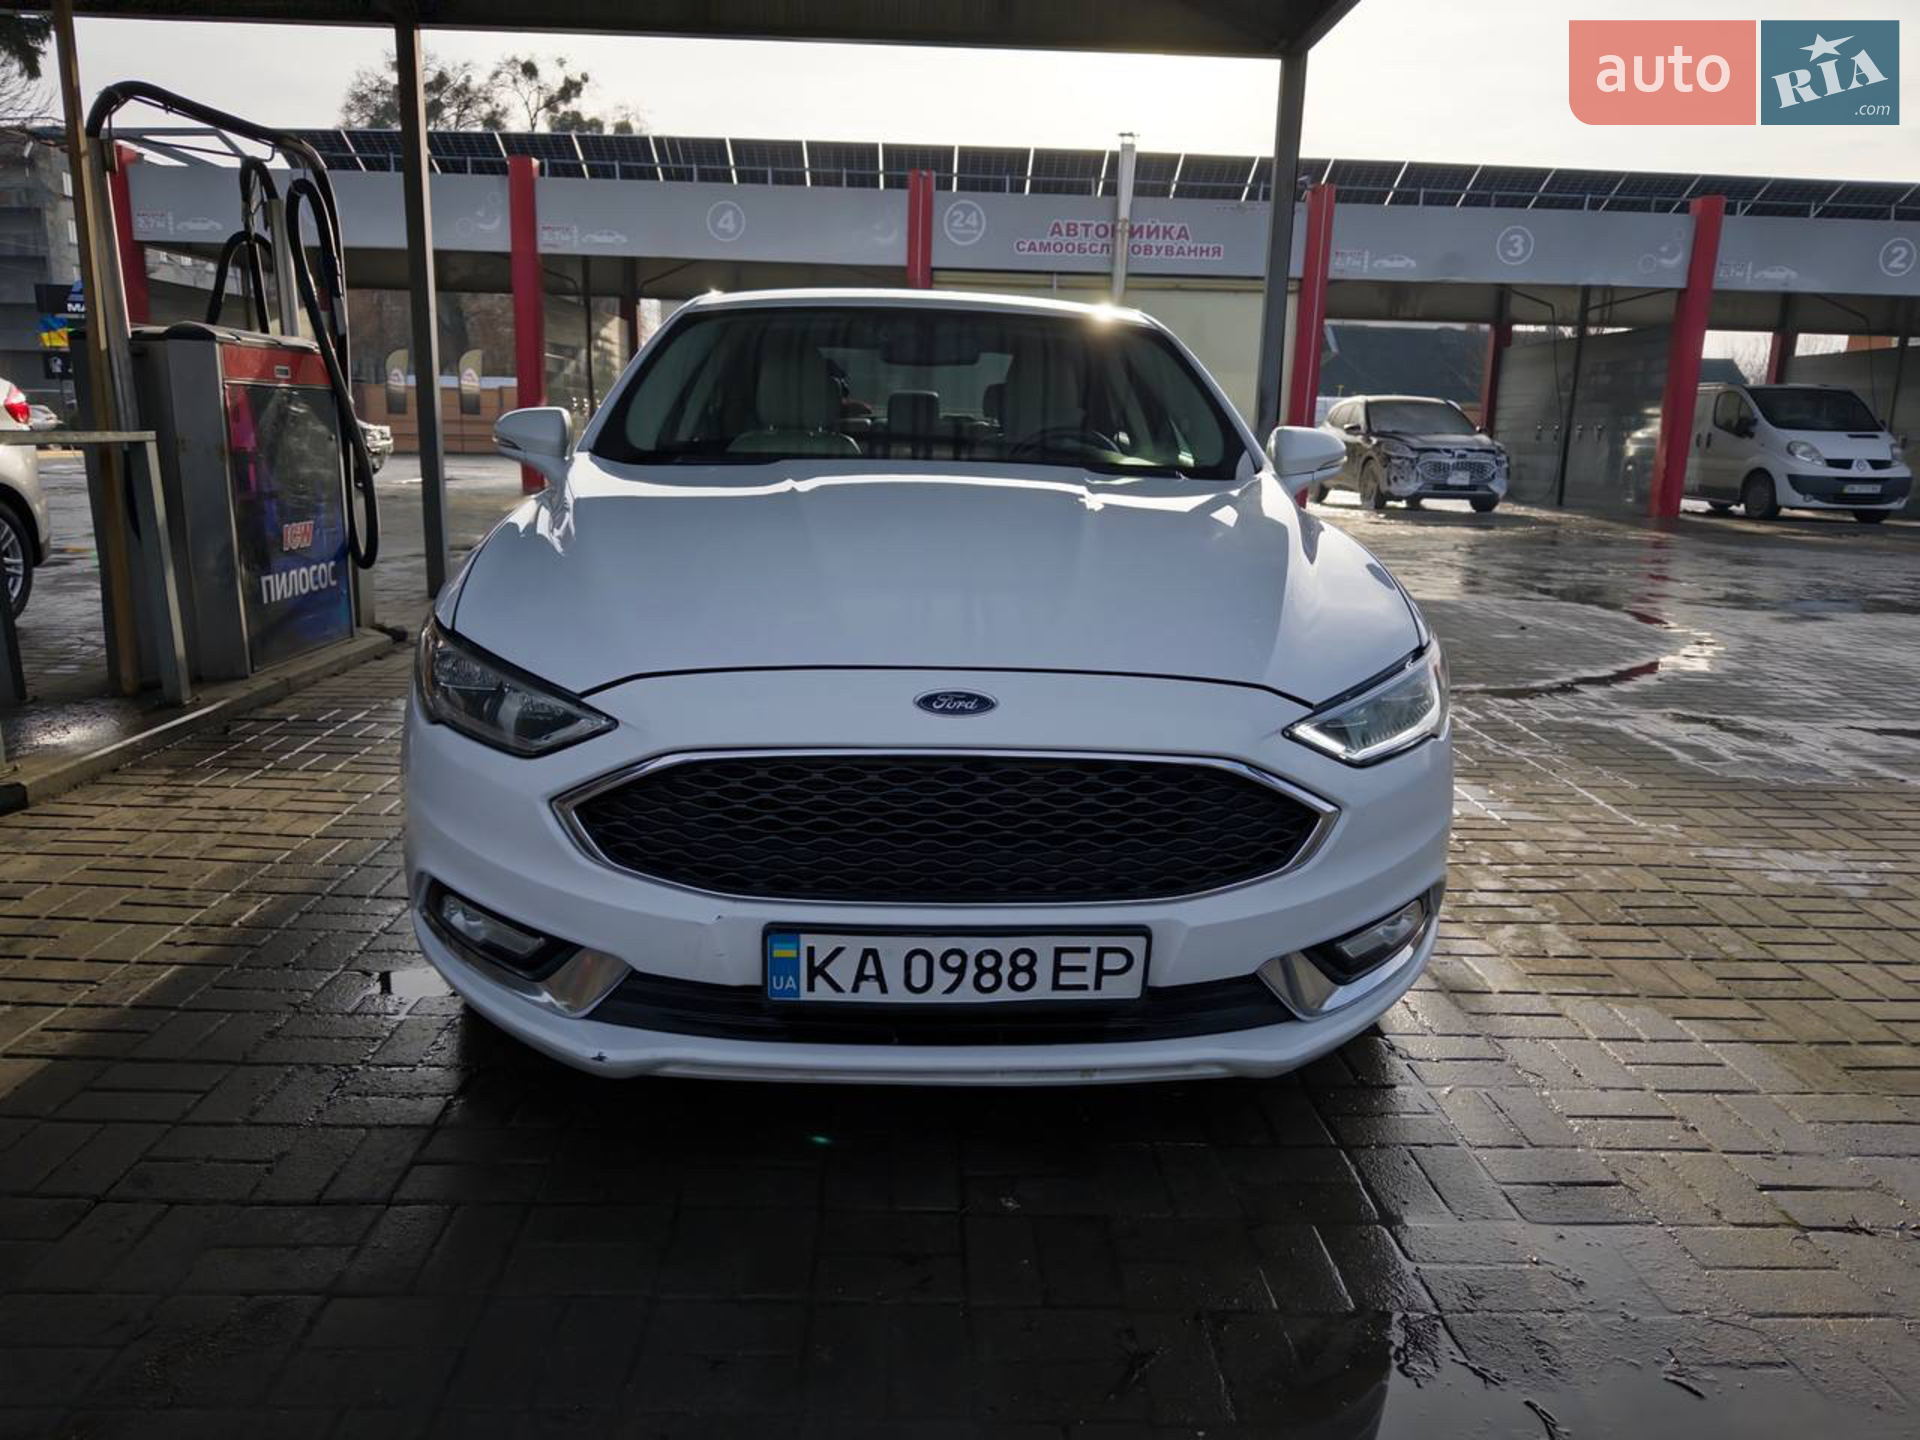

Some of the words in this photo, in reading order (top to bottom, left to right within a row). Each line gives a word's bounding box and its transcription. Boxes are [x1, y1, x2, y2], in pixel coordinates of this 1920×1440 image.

[717, 209, 735, 233] 4
[951, 209, 978, 228] 24
[1016, 240, 1223, 258] САМООБСЛОВУВАННЯ
[1506, 234, 1524, 257] 3
[1888, 246, 1908, 269] 2
[260, 561, 337, 605] ПИЛОСОС
[932, 694, 980, 710] Ford
[806, 945, 889, 994] KA
[903, 947, 1038, 995] 0988
[1051, 946, 1135, 992] EP
[772, 976, 797, 991] UA
